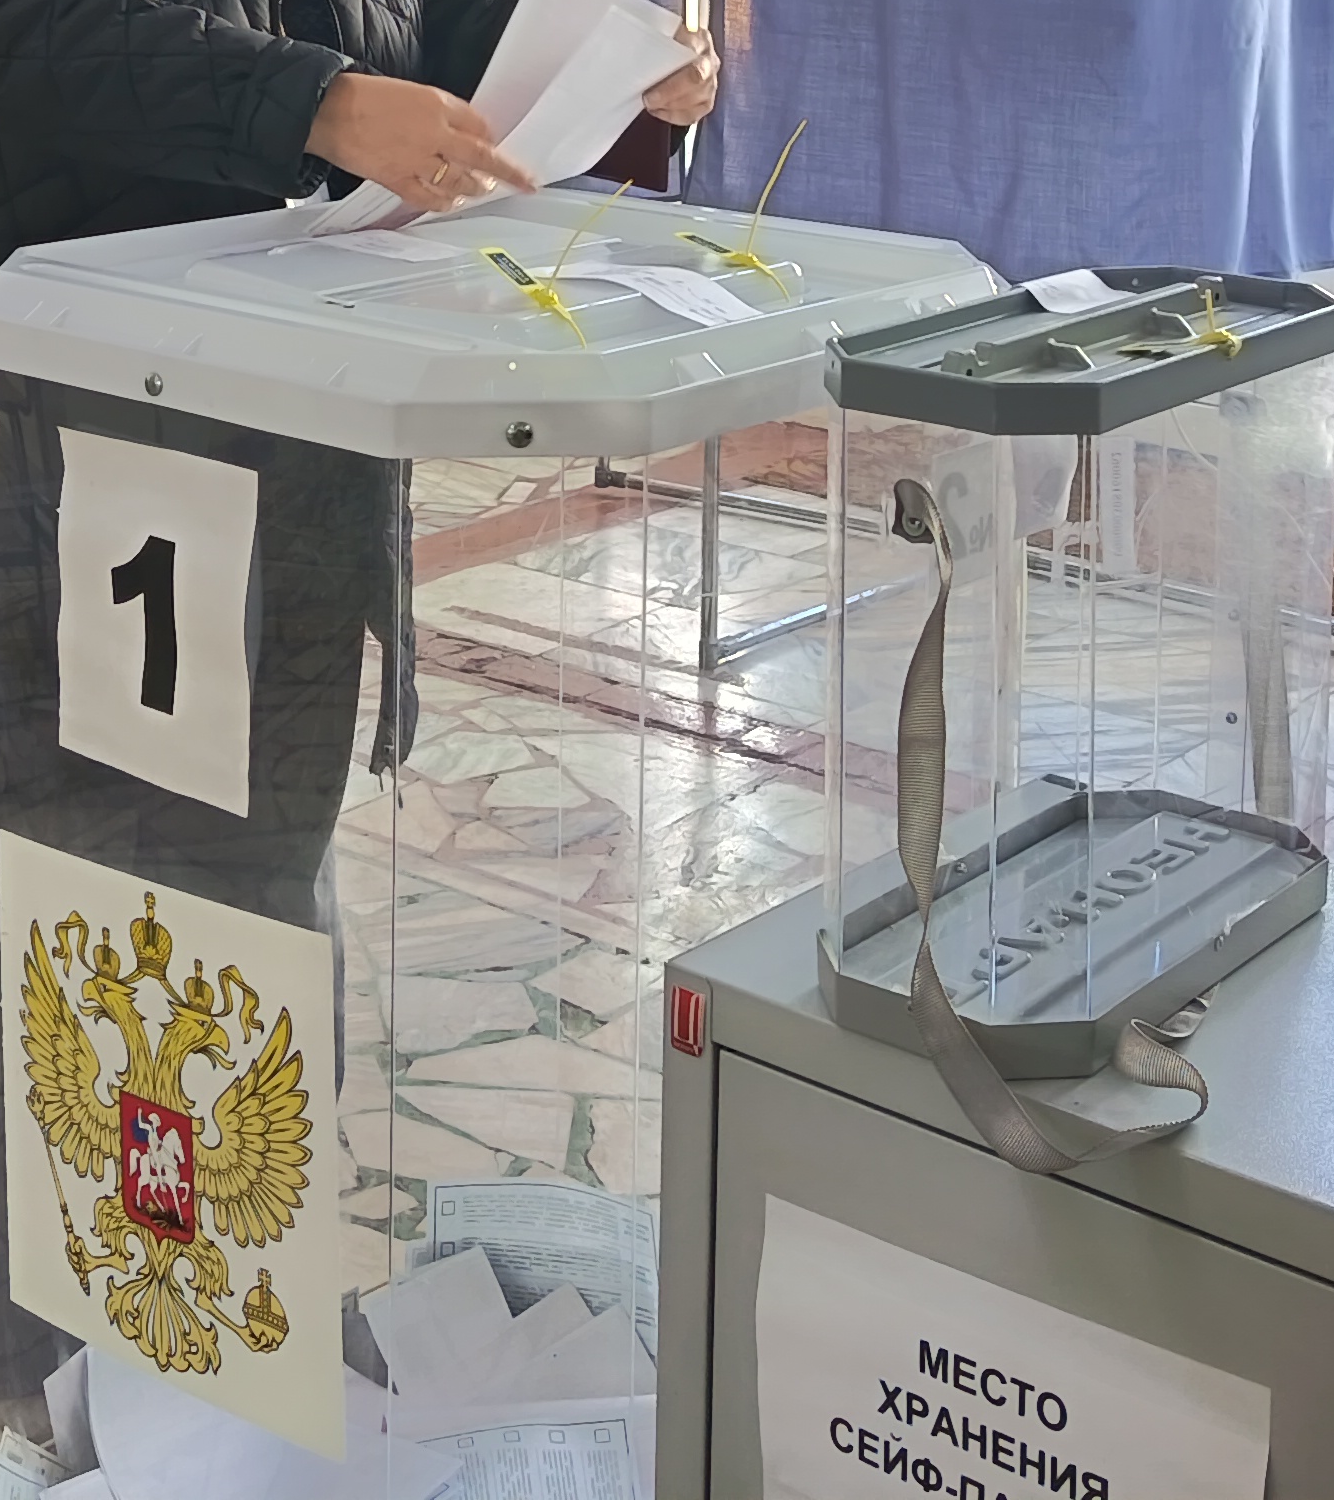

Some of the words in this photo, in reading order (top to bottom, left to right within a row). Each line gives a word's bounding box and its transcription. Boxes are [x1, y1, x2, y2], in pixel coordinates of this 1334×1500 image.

[109, 534, 178, 717] 1
[877, 1378, 1109, 1500] ХРАНЕНИЯ
[919, 1338, 1068, 1432] МЕСТО
[830, 1417, 1008, 1500] СЕЙФ-П
